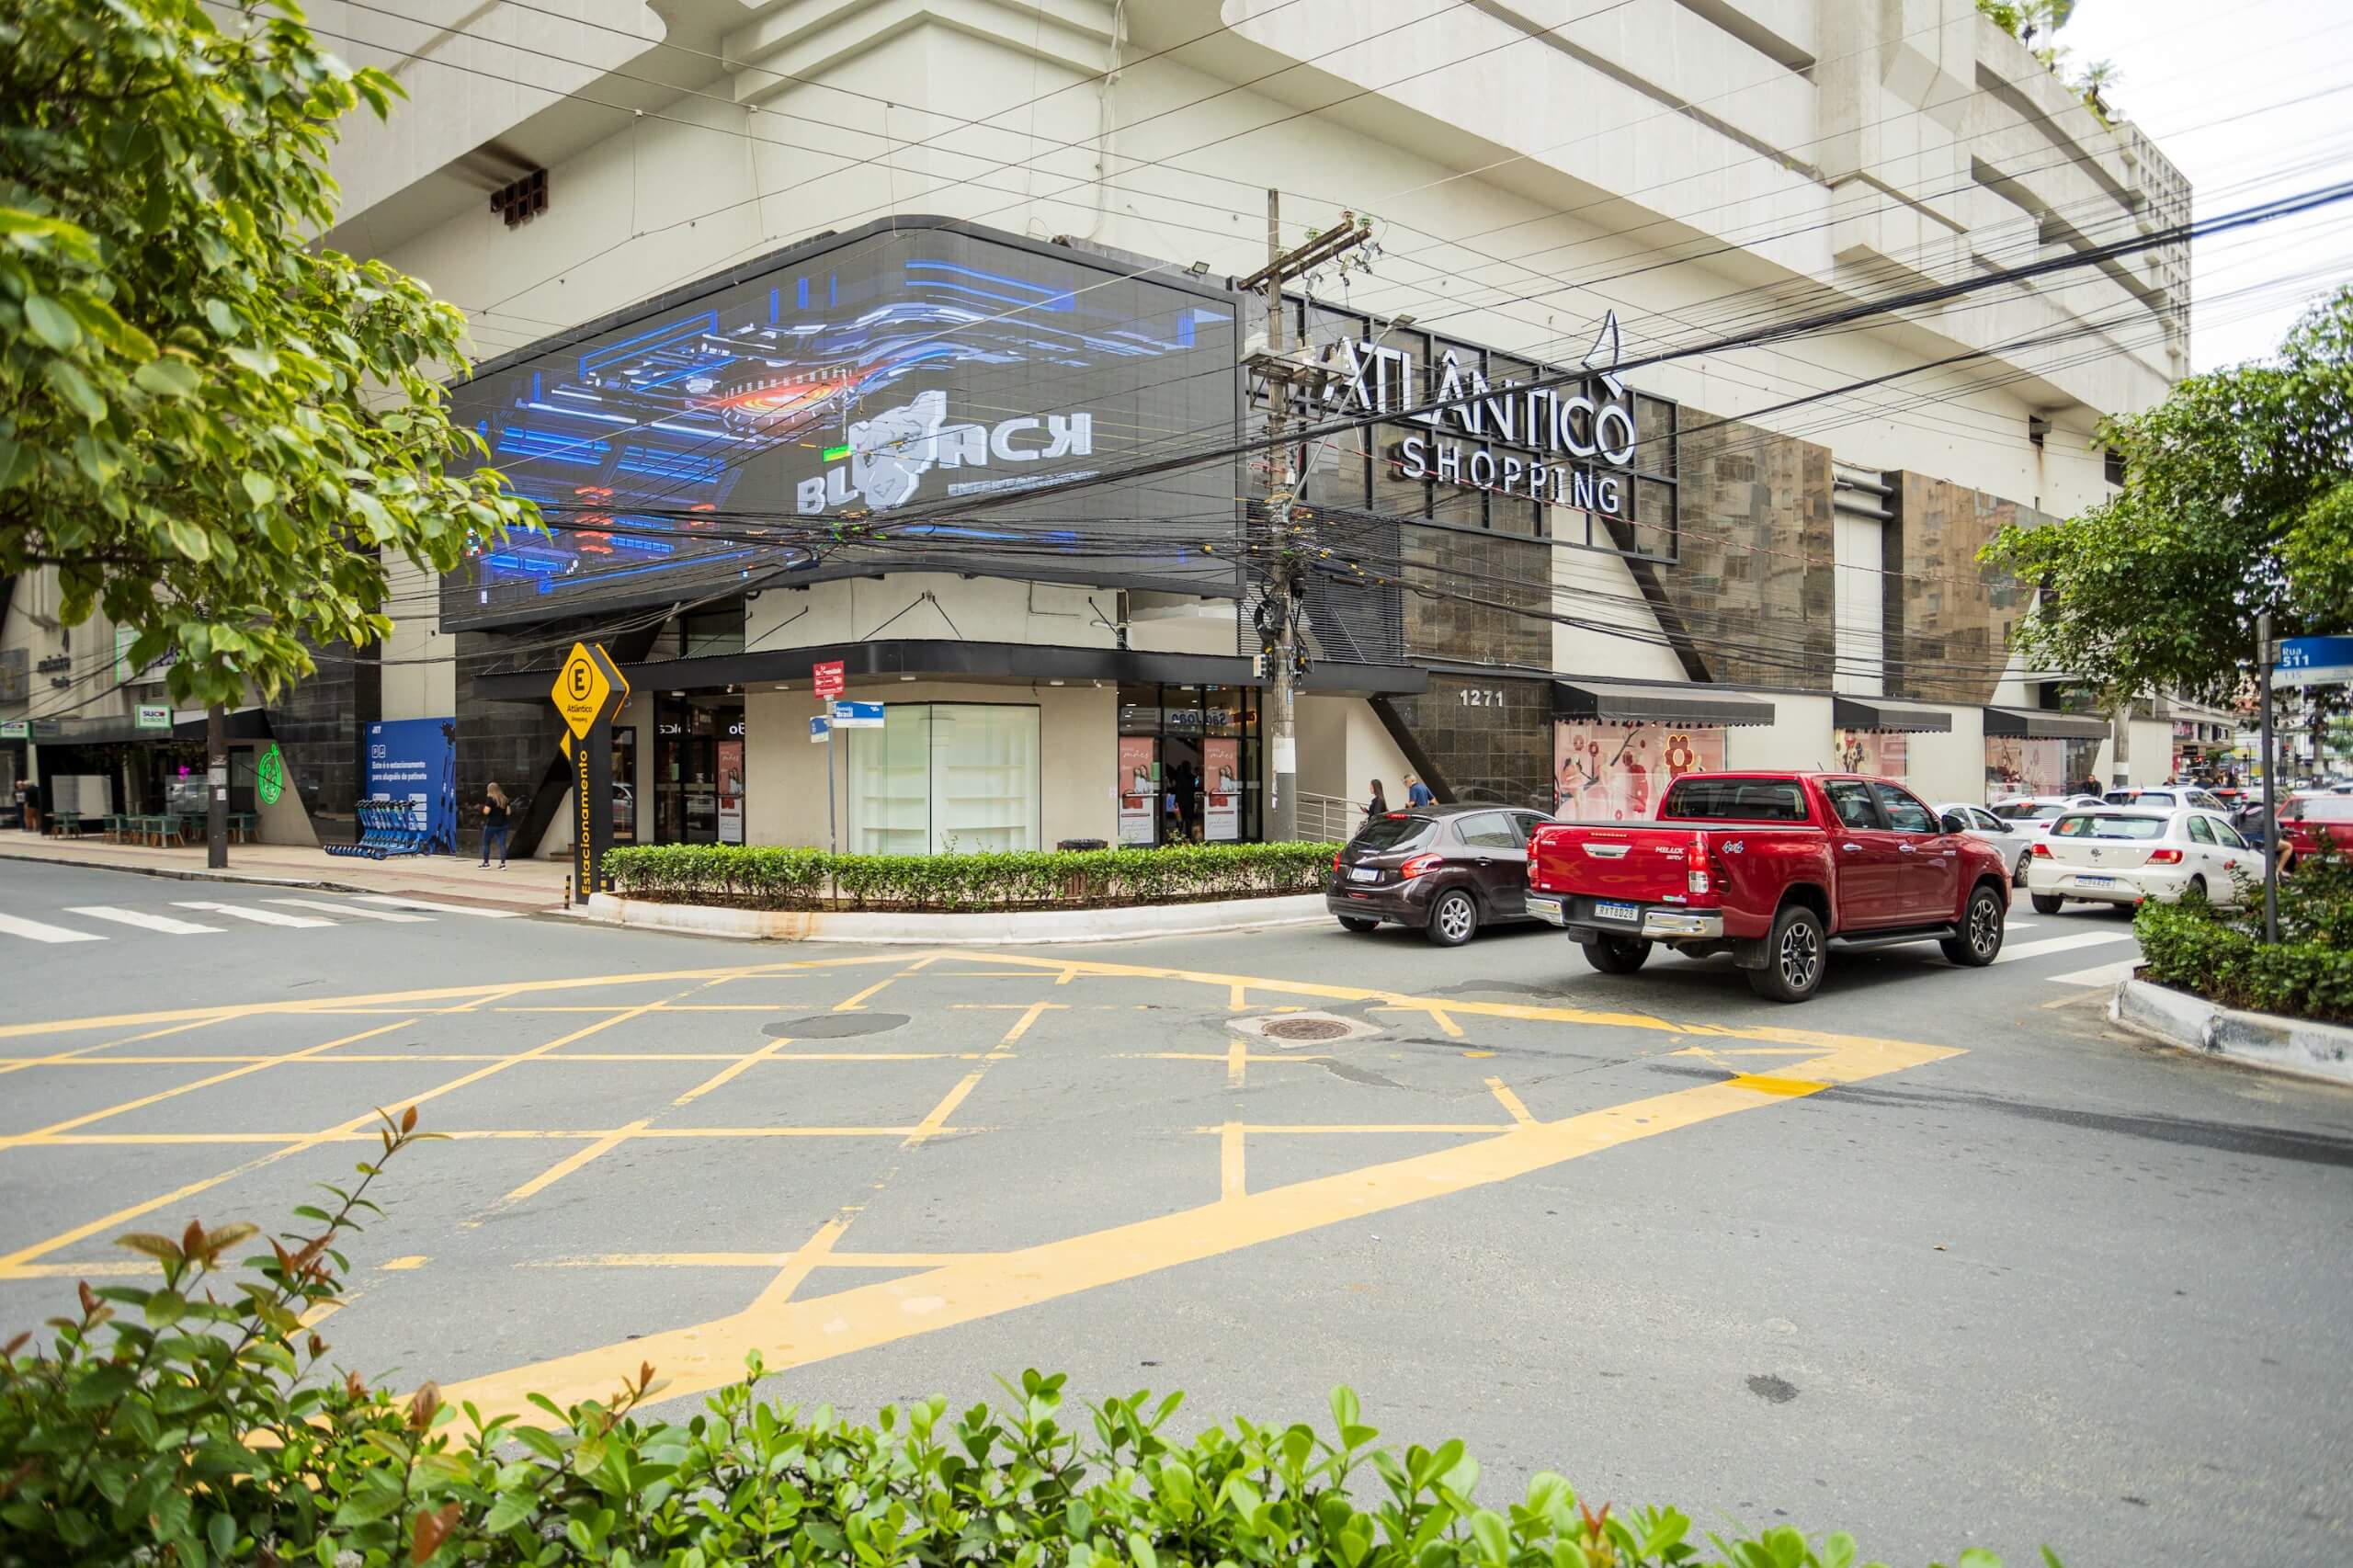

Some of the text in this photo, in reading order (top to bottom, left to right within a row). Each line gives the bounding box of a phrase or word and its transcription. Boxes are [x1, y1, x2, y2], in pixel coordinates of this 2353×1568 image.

[1321, 335, 1636, 466] ATLÂNTICO
[1402, 437, 1620, 514] SHOPPING
[2282, 646, 2302, 655] Rua
[2282, 654, 2310, 667] 511
[574, 668, 585, 691] E
[1459, 688, 1504, 708] 1271
[566, 703, 593, 713] Atlântico
[578, 750, 591, 895] Estacionamento
[1654, 846, 1685, 855] HILUX
[1721, 840, 1745, 854] 4x4
